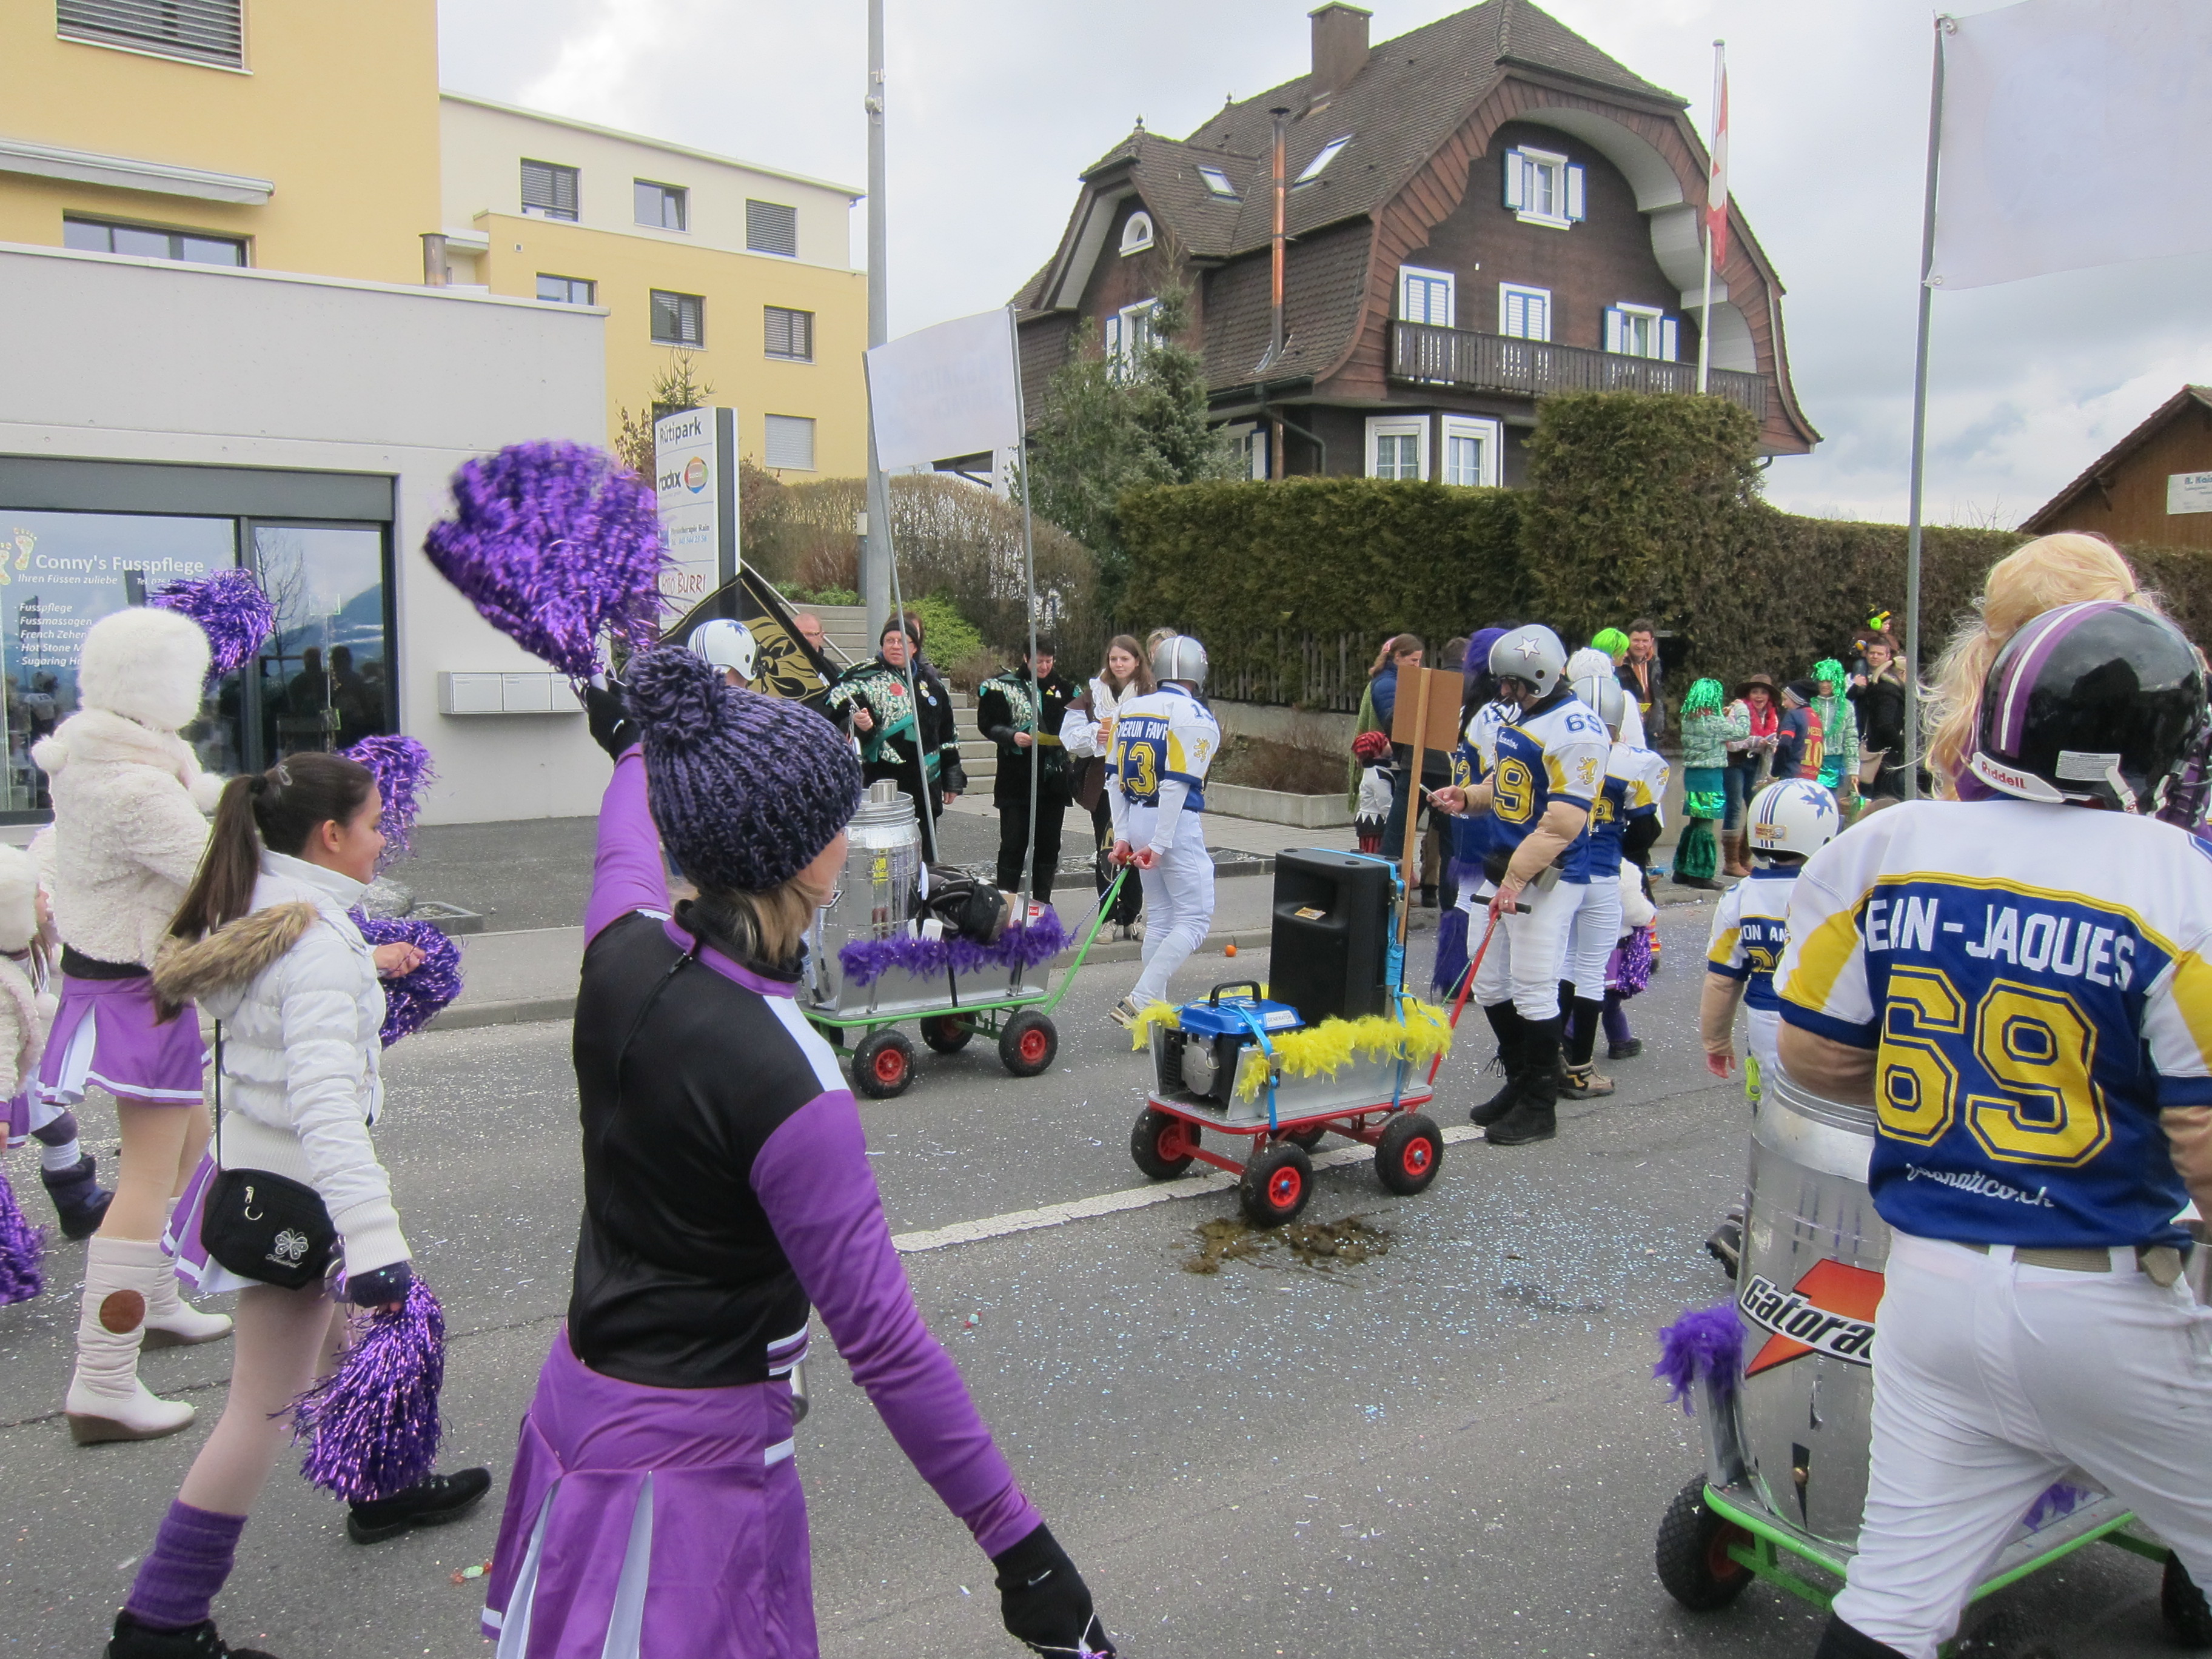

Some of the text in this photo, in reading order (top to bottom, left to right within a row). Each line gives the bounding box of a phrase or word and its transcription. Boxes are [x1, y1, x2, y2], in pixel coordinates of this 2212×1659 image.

[660, 417, 702, 445] Rütipark
[35, 554, 205, 575] Conny's Fusspflege
[18, 574, 44, 583] Ihren
[47, 574, 81, 583] Füssen
[83, 575, 118, 584] zuliebe
[677, 572, 706, 594] BURRI
[19, 603, 73, 613] Fusspflege
[20, 616, 92, 626] Fussmassagen
[21, 629, 55, 638] French
[21, 643, 39, 652] Hot
[42, 643, 71, 652] Stone
[21, 657, 67, 666] Sugaring
[1564, 712, 1603, 737] 69
[1801, 739, 1823, 768] 10
[1875, 964, 2113, 1168] 69
